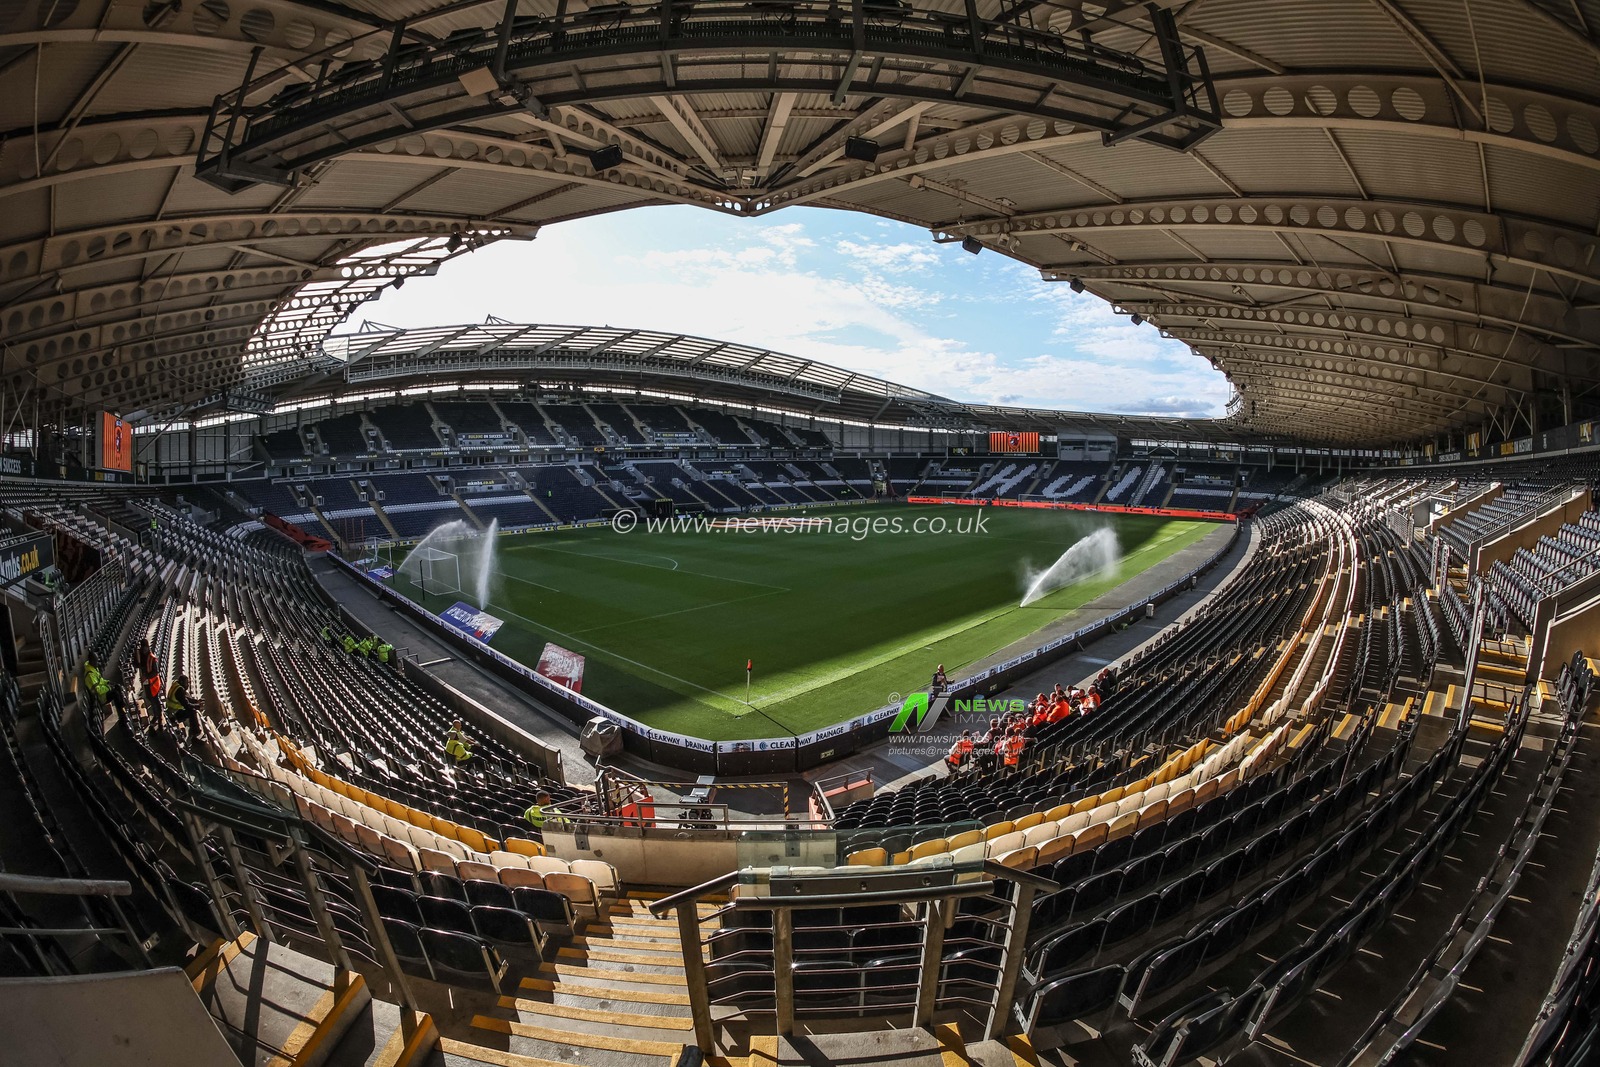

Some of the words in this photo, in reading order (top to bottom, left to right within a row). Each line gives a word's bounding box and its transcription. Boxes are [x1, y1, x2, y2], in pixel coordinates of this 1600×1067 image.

[948, 682, 968, 693] CLEARWAY
[582, 700, 602, 714] CLEARWAY
[874, 706, 900, 721] CLEARWAY
[647, 732, 680, 745] CLEARWAY
[770, 736, 812, 750] CLEARWAY
[816, 726, 844, 742] DRAINAGE
